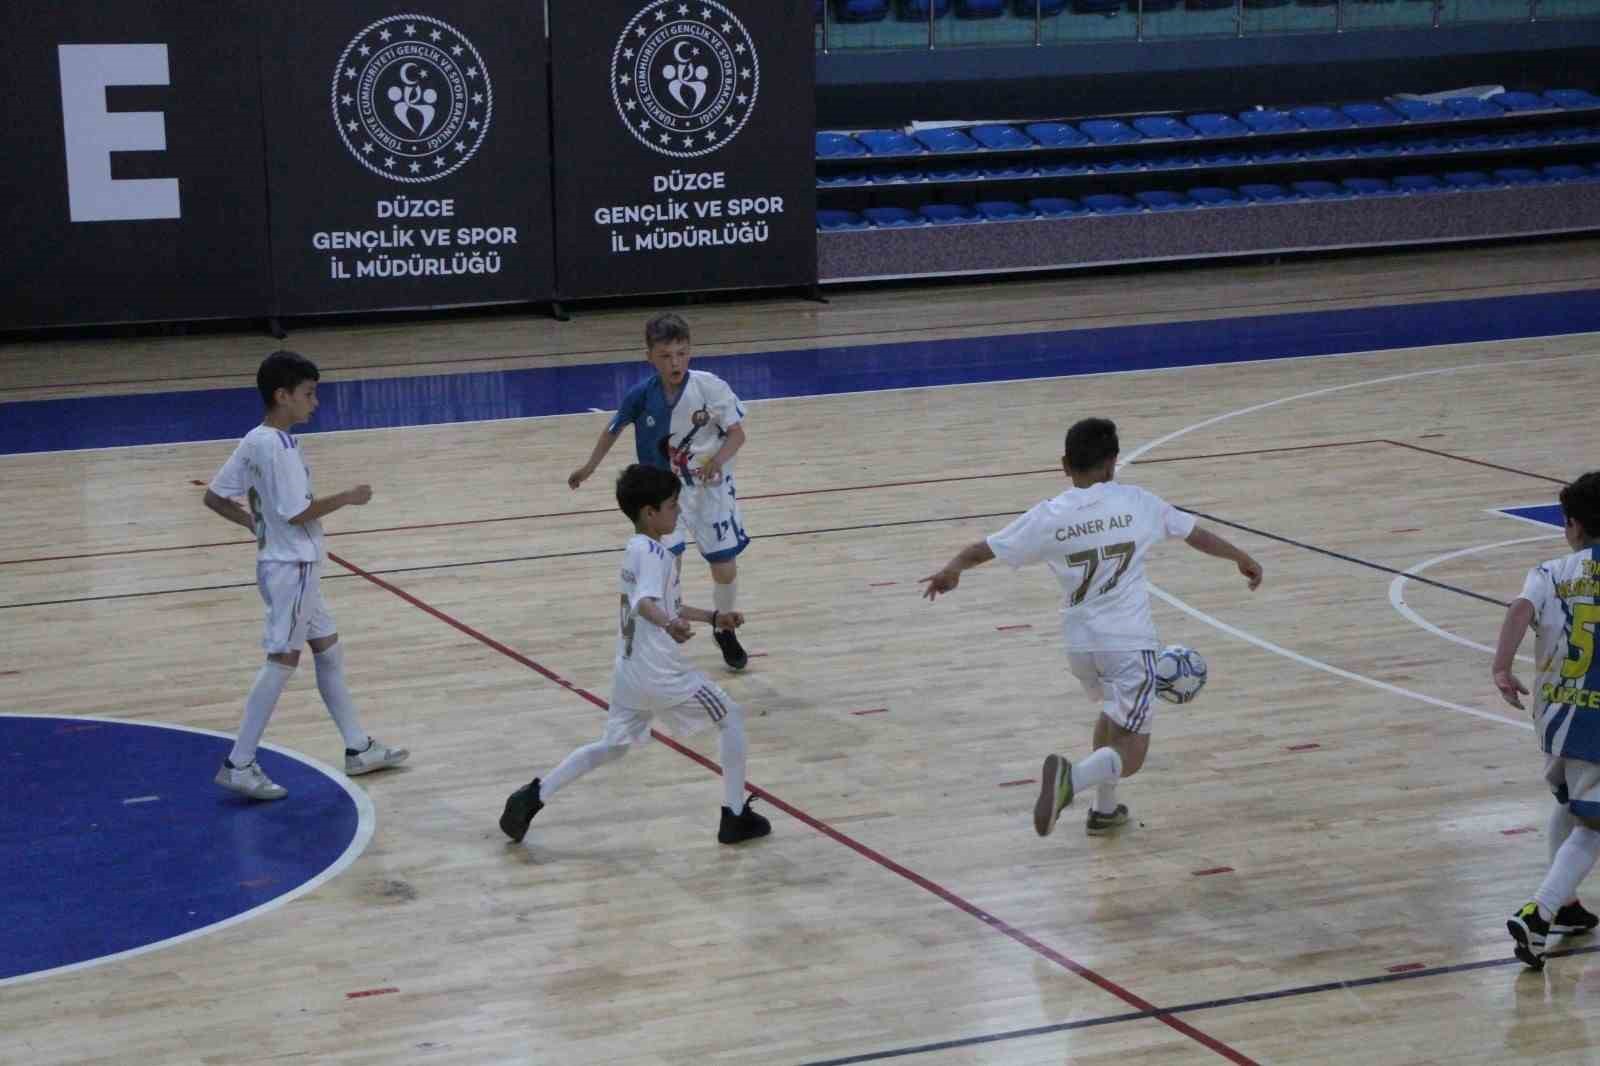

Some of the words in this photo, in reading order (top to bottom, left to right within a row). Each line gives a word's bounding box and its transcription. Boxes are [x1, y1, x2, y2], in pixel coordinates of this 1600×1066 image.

[711, 35, 723, 50] VE
[719, 48, 733, 75] SPOR
[441, 58, 453, 72] VE
[449, 71, 464, 100] SPOR
[58, 43, 181, 222] E
[653, 169, 726, 193] DÜZCE
[377, 195, 455, 218] DÜZCE
[594, 198, 689, 227] GENÇLİK
[694, 201, 722, 218] VE
[727, 197, 785, 216] SPOR
[312, 224, 415, 253] GENÇLİK
[420, 228, 451, 247] VE
[456, 227, 518, 246] SPOR
[611, 230, 630, 253] İL
[635, 220, 769, 251] MÜDÜRLÜĞÜ
[330, 256, 351, 279] İL
[356, 251, 502, 278] MÜDÜRLÜĞÜ
[1055, 519, 1105, 542] CANER
[1109, 514, 1134, 530] ALP
[1065, 541, 1136, 607] 77
[1560, 603, 1600, 679] 5
